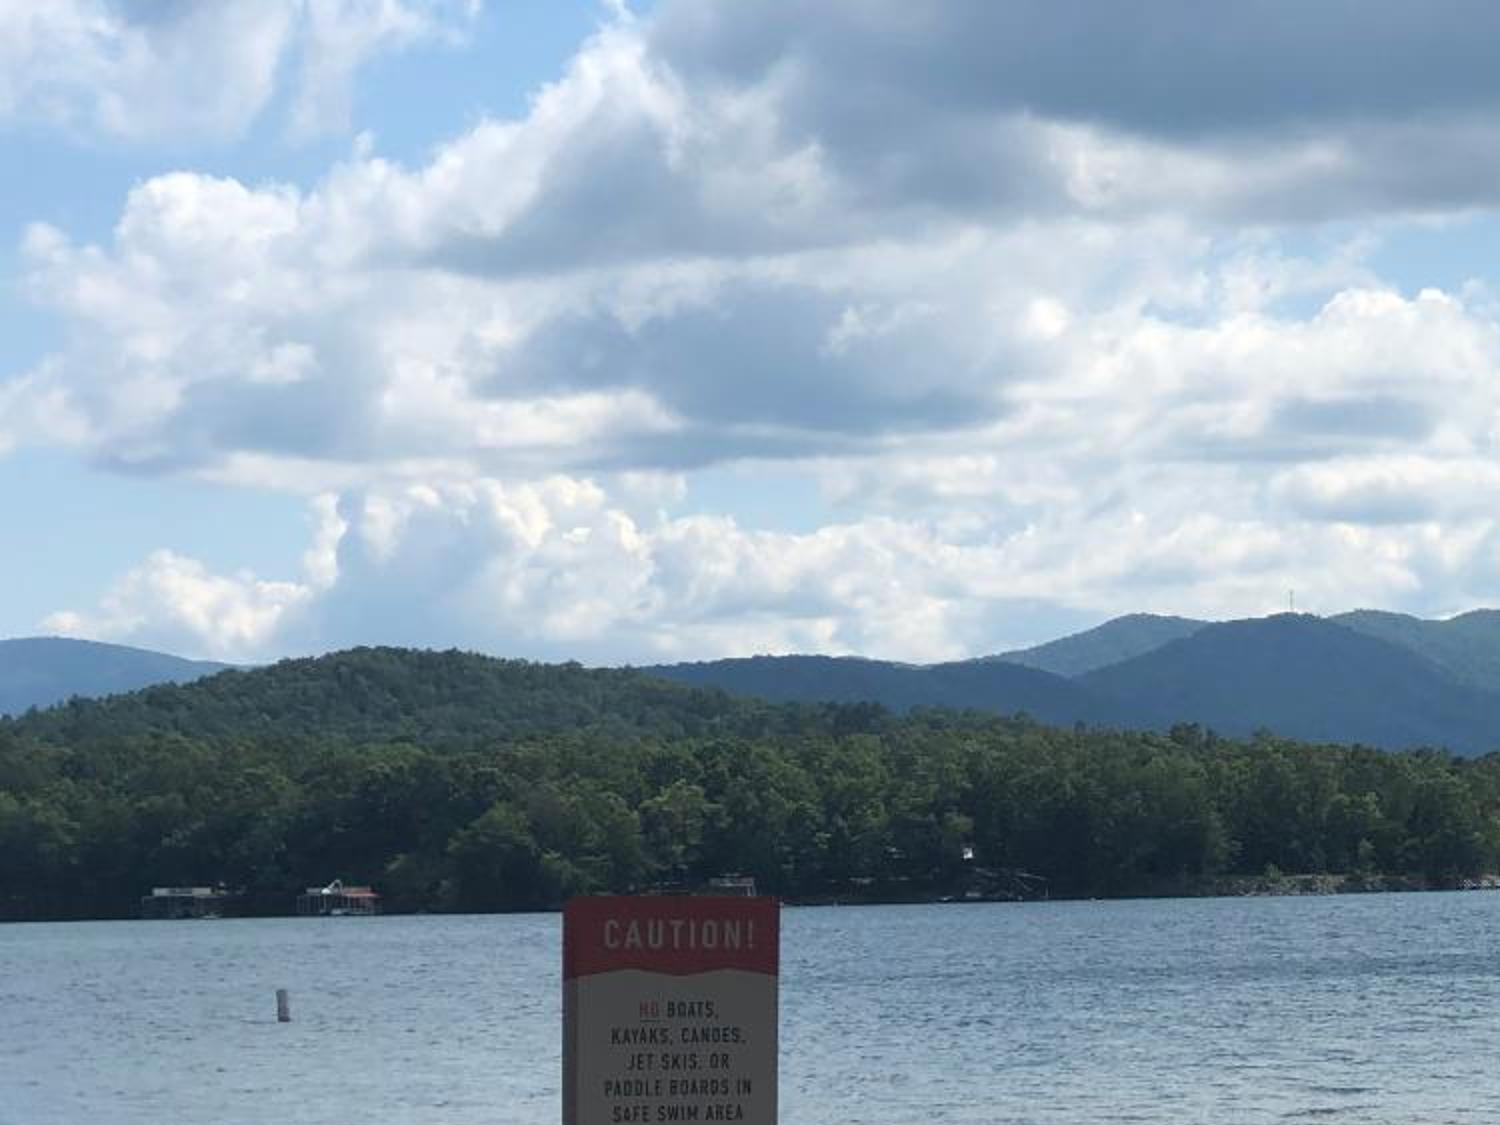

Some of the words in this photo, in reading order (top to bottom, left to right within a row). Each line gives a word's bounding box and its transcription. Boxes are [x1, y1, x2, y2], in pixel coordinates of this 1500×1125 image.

[604, 919, 753, 950] CAUTION!
[611, 1028, 673, 1046] KAYAKS,
[627, 1054, 653, 1071] JET
[709, 1053, 730, 1069] OR
[604, 1080, 663, 1097] PADDLE
[670, 1080, 729, 1096] BOARDS
[737, 1079, 752, 1096] IN
[613, 1106, 649, 1123] SAFE
[657, 1105, 698, 1121] SWIM
[705, 1104, 743, 1121] AREA
